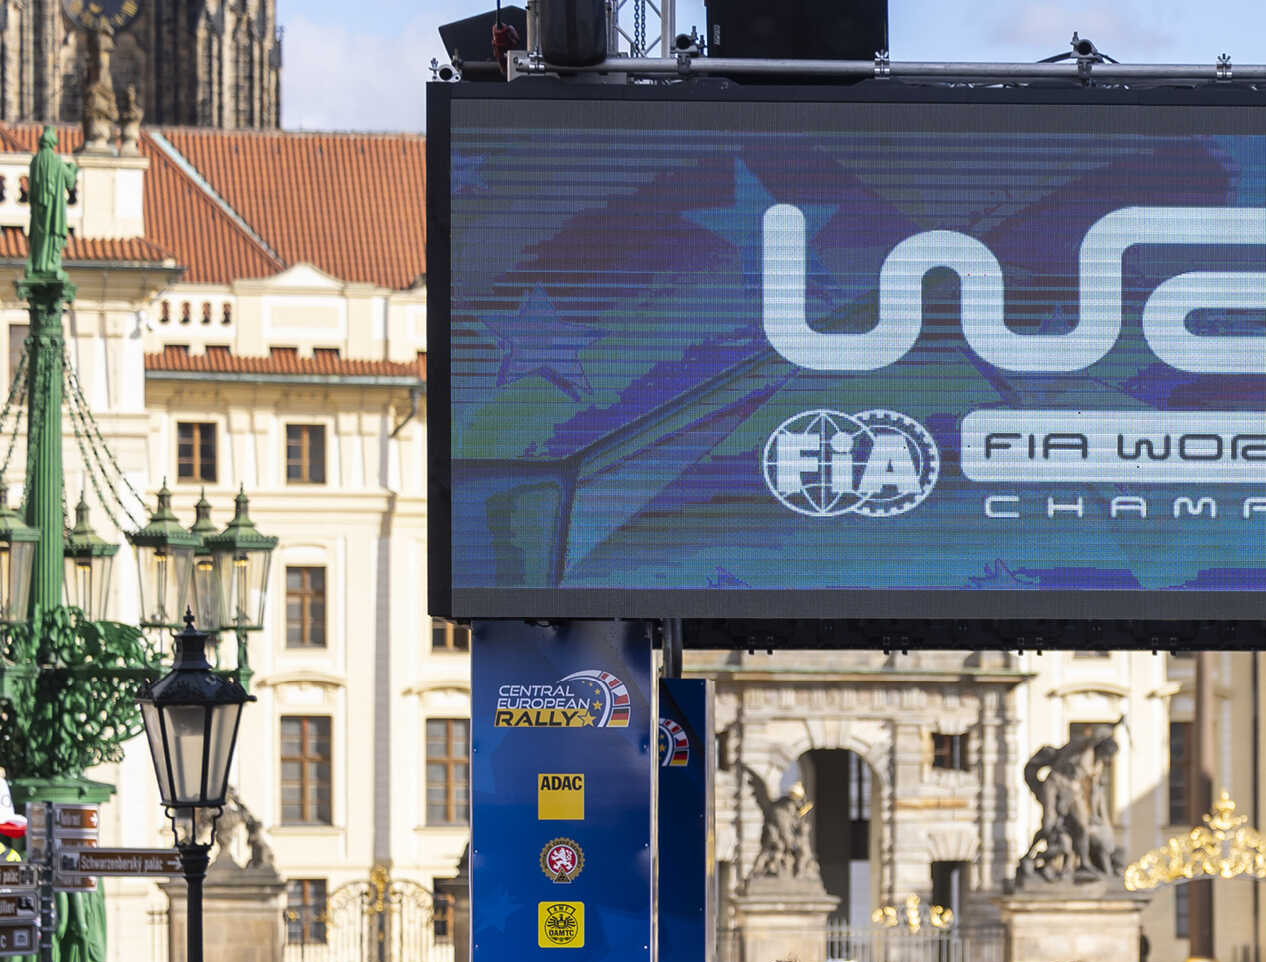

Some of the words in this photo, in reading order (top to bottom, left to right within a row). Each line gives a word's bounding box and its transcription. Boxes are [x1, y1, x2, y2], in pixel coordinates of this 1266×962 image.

[984, 431, 1089, 461] FIA
[498, 684, 575, 697] CENTRAL
[496, 698, 590, 709] EUROPEAN
[494, 711, 579, 727] RALLY
[540, 775, 583, 791] ADAC
